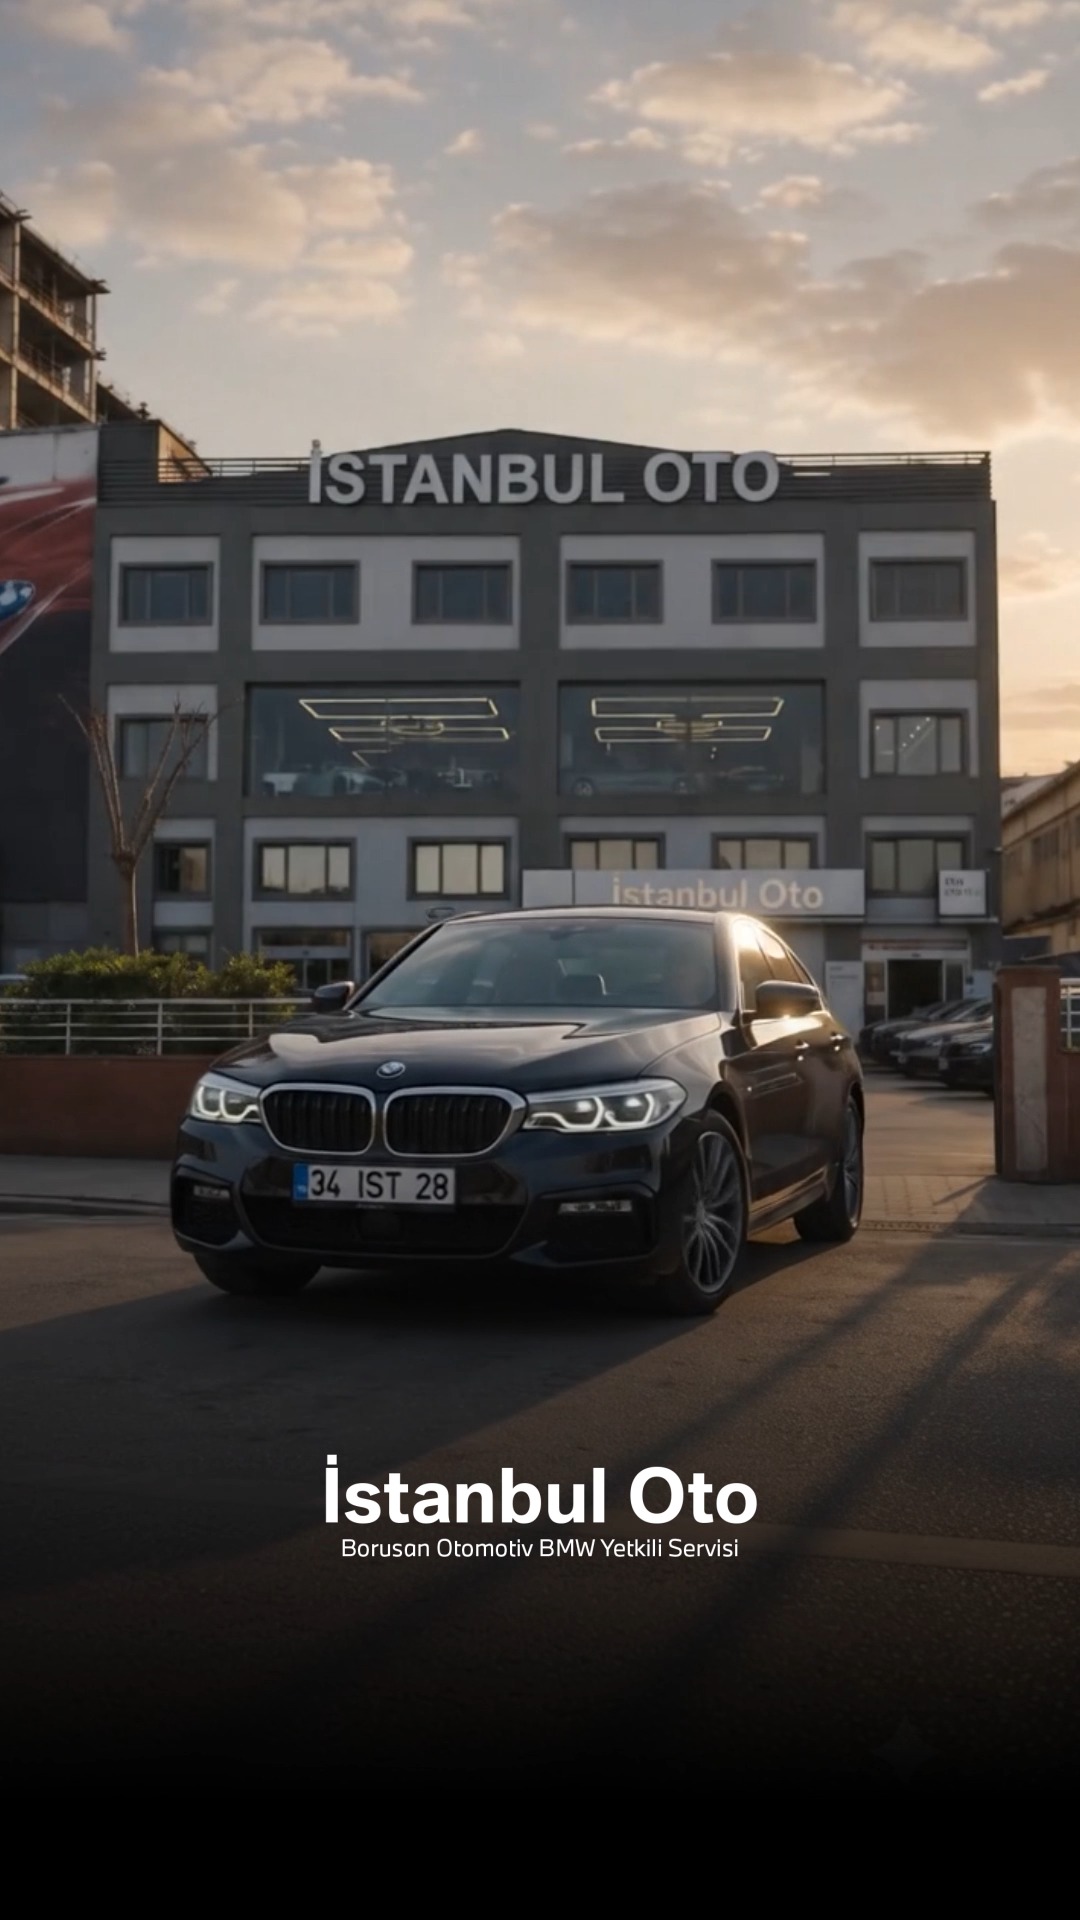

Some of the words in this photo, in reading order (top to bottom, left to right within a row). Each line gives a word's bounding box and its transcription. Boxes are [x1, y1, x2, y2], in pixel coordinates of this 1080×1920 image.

[309, 439, 625, 504] İSTANBUL
[643, 451, 780, 503] OTO
[758, 879, 824, 909] Oto
[311, 1169, 341, 1198] 34
[358, 1170, 402, 1200] IST
[416, 1172, 448, 1201] 28
